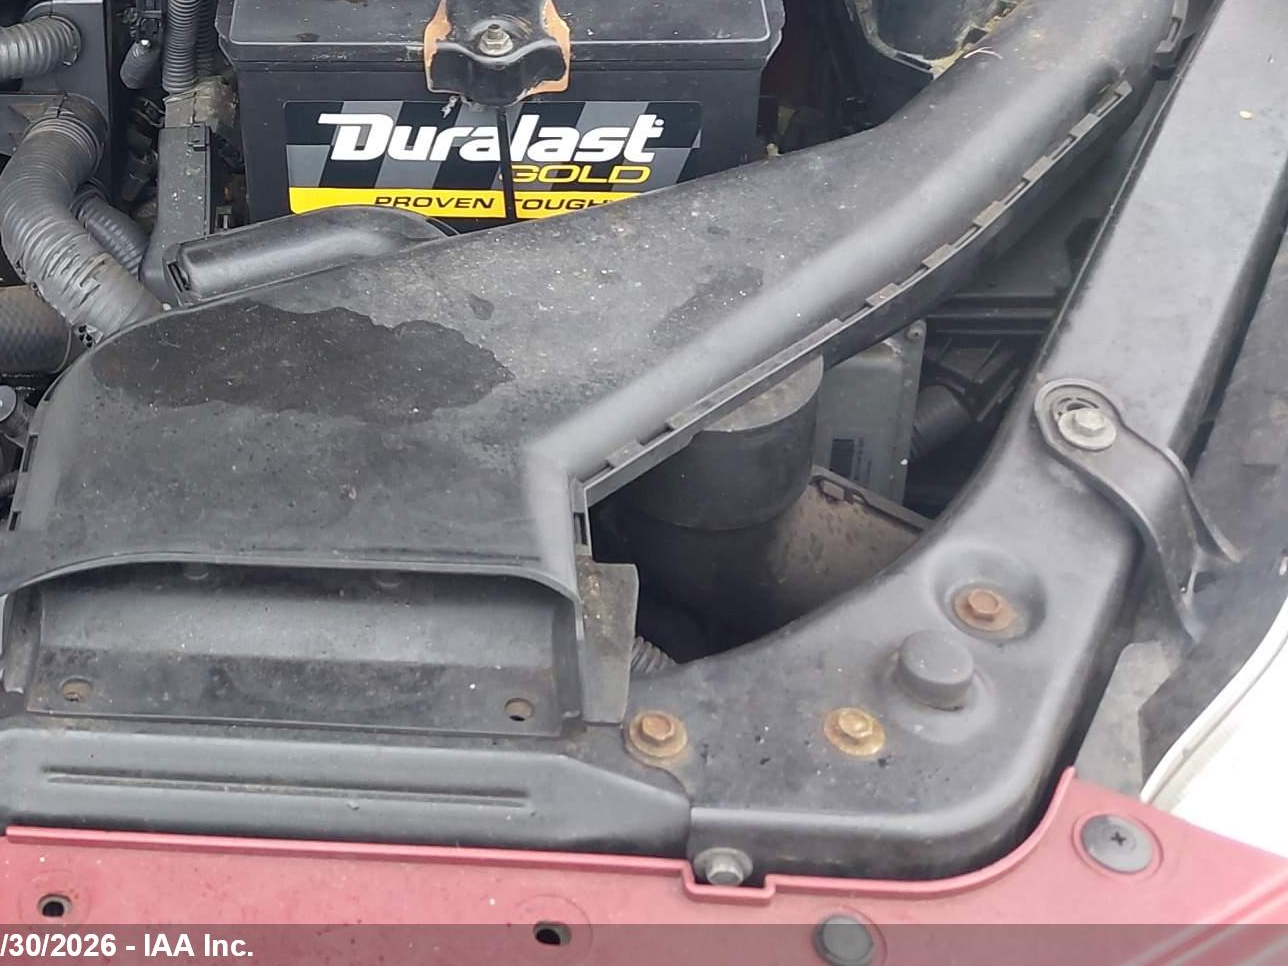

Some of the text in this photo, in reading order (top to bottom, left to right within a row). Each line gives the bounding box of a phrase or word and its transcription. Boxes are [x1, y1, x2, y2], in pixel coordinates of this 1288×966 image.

[317, 113, 665, 163] Duralast
[511, 164, 651, 184] GOLD
[374, 196, 494, 210] PROVEN
